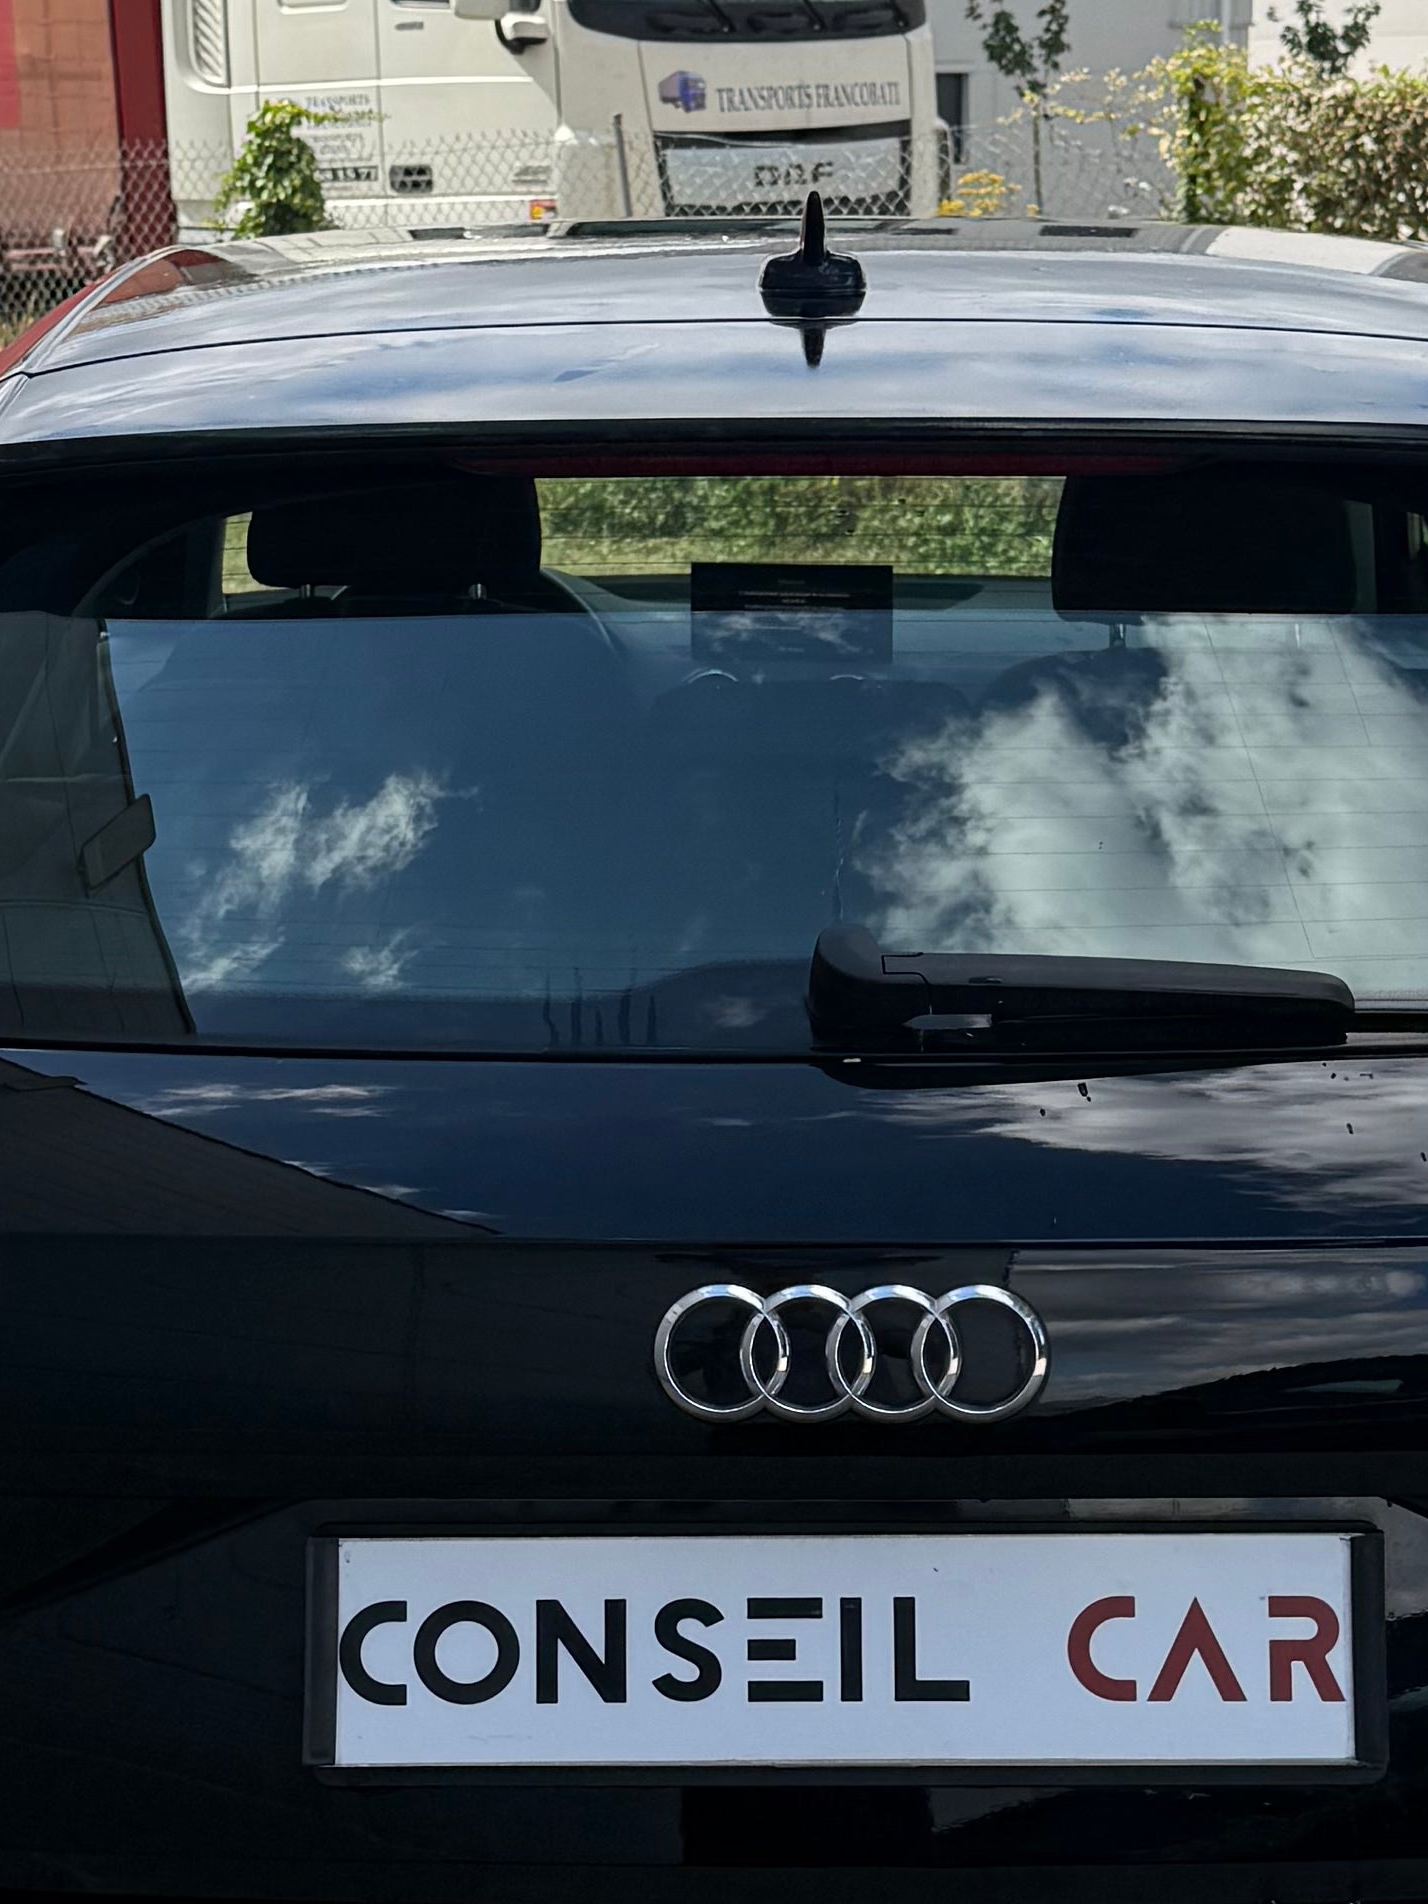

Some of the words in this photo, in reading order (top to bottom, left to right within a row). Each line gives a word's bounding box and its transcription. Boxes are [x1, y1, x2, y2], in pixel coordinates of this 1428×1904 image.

[716, 83, 812, 113] TRANSPORTS
[338, 1596, 972, 1705] CONSEIL
[1067, 1595, 1347, 1703] CAR
